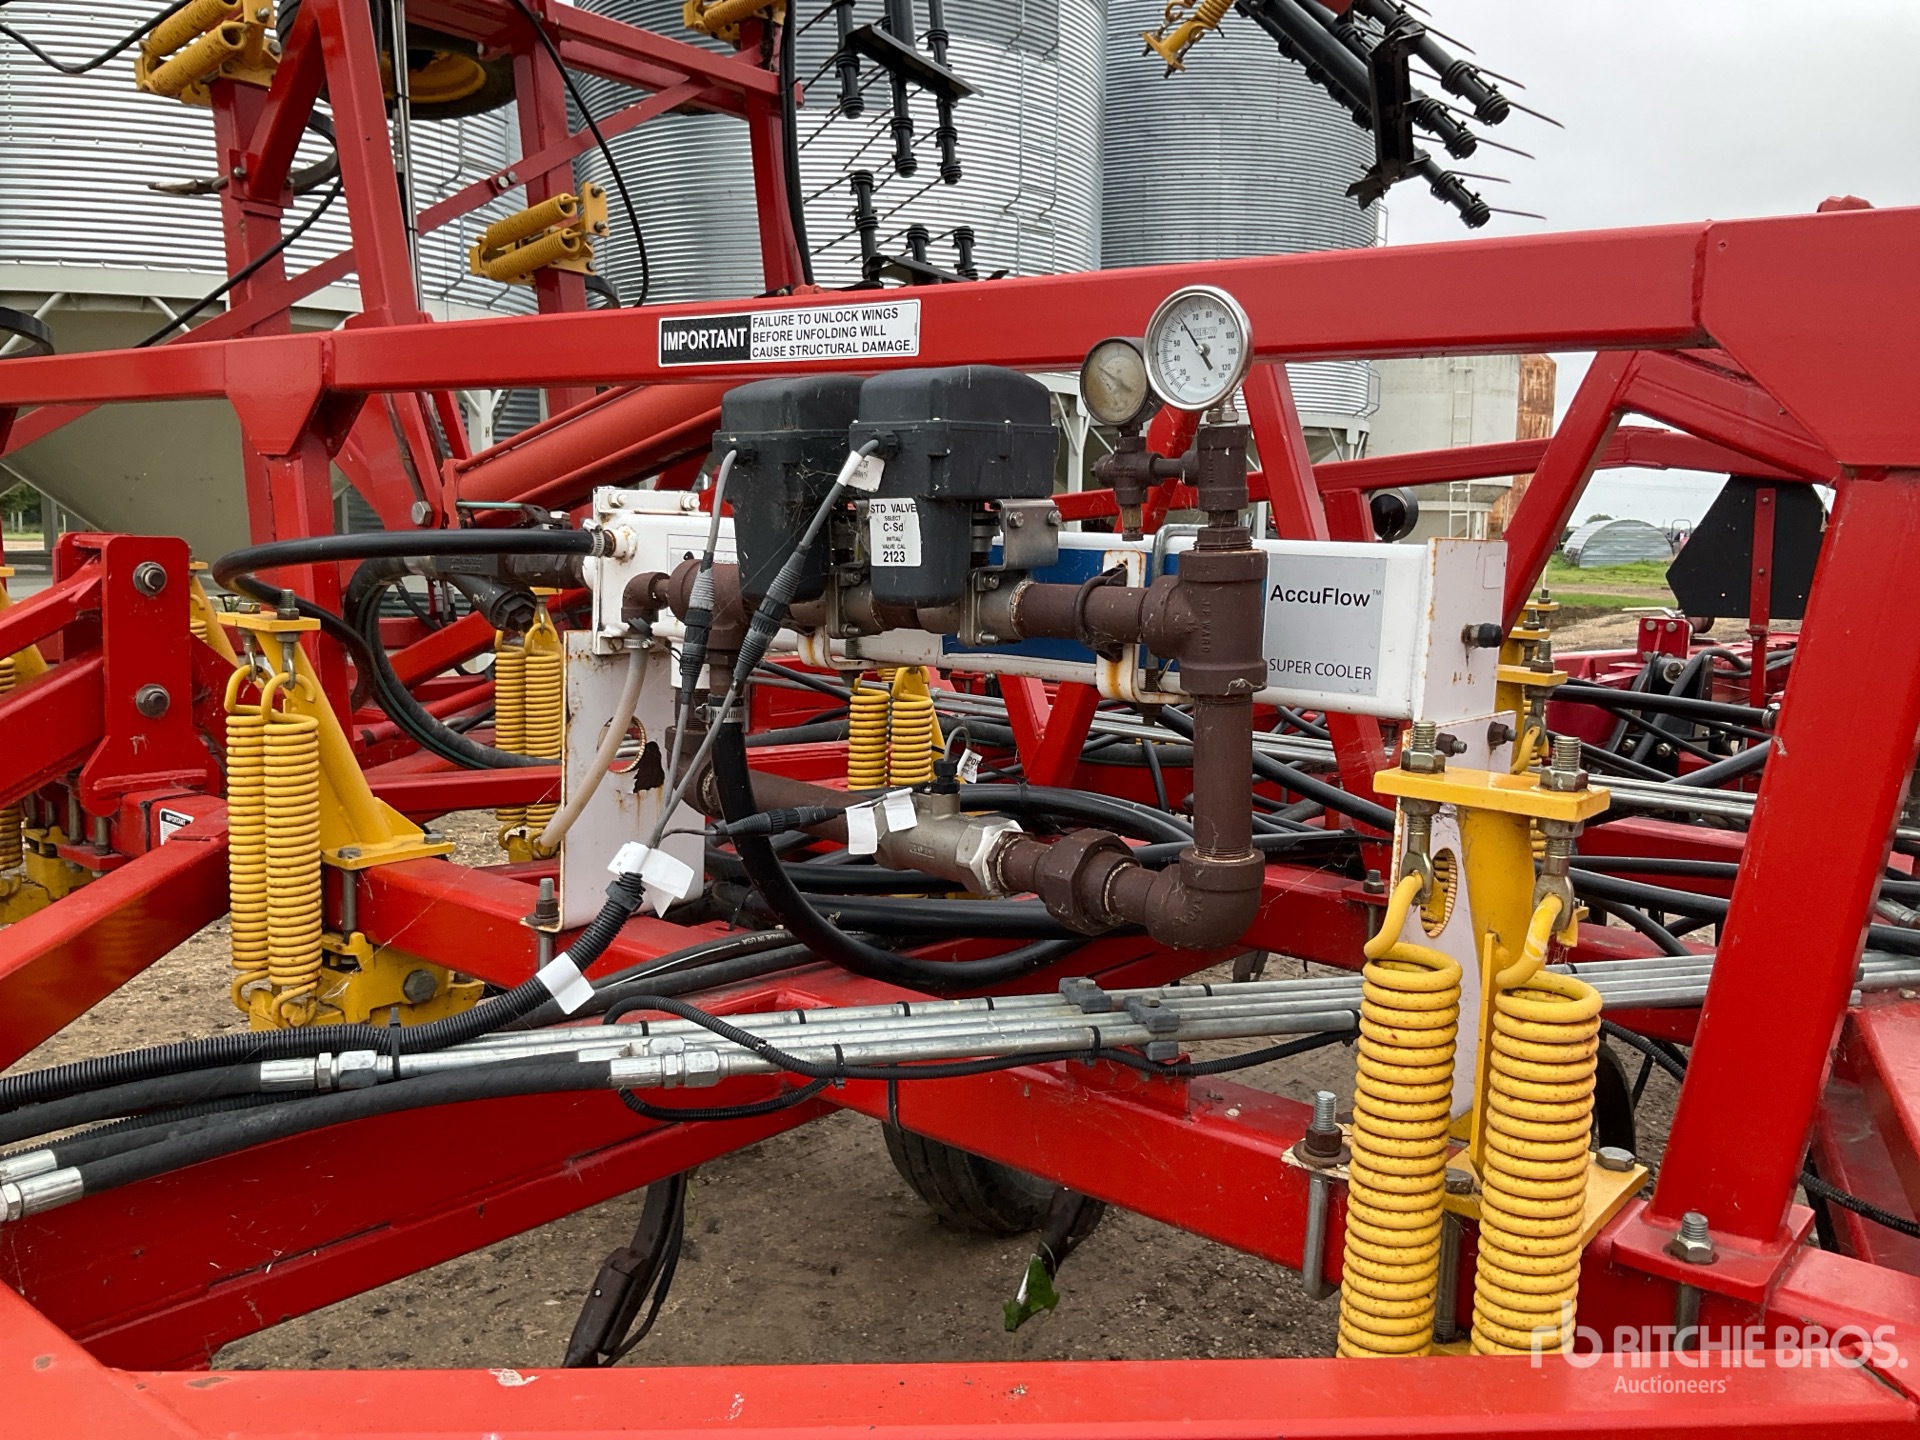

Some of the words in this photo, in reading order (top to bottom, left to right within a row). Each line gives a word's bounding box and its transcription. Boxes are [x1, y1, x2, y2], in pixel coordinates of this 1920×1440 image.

[753, 315, 794, 328] FAILURE
[798, 313, 811, 325] TO
[814, 310, 859, 324] UNLOCK
[862, 307, 898, 321] WINGS
[663, 327, 747, 351] IMPORTANT
[753, 330, 793, 343] BEFORE
[796, 326, 857, 341] UNFOLDING
[860, 325, 886, 337] WILL
[752, 346, 786, 358] CAUSE
[789, 342, 859, 356] STRUCTURAL
[862, 340, 914, 353] DAMAGE.
[870, 504, 886, 513] STD
[890, 503, 917, 513] VALVE
[883, 551, 906, 563] 2123
[1269, 658, 1312, 675] SUPER
[1314, 662, 1372, 681] COOLER
